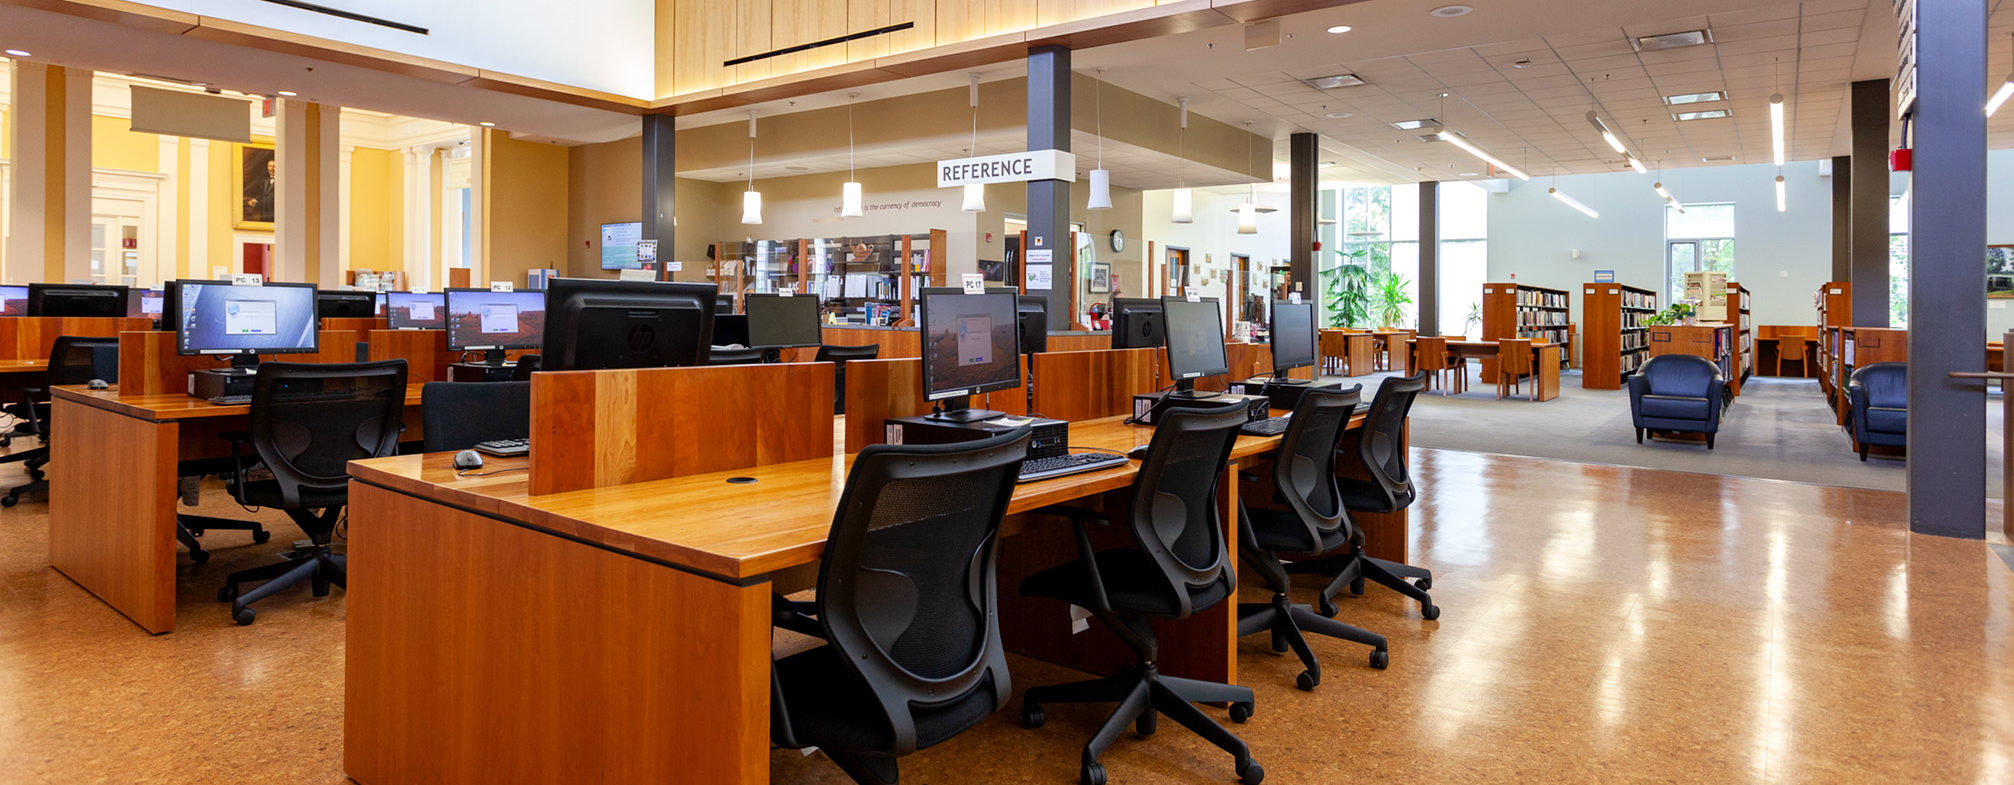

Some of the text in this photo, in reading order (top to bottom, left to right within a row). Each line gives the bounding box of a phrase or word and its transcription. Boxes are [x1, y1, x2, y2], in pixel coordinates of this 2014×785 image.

[943, 158, 1032, 181] REFERENCE
[869, 202, 879, 211] the
[879, 202, 903, 210] currency
[903, 200, 910, 209] of
[911, 200, 942, 208] democracy
[966, 280, 982, 289] PC 17
[631, 324, 652, 352] hp
